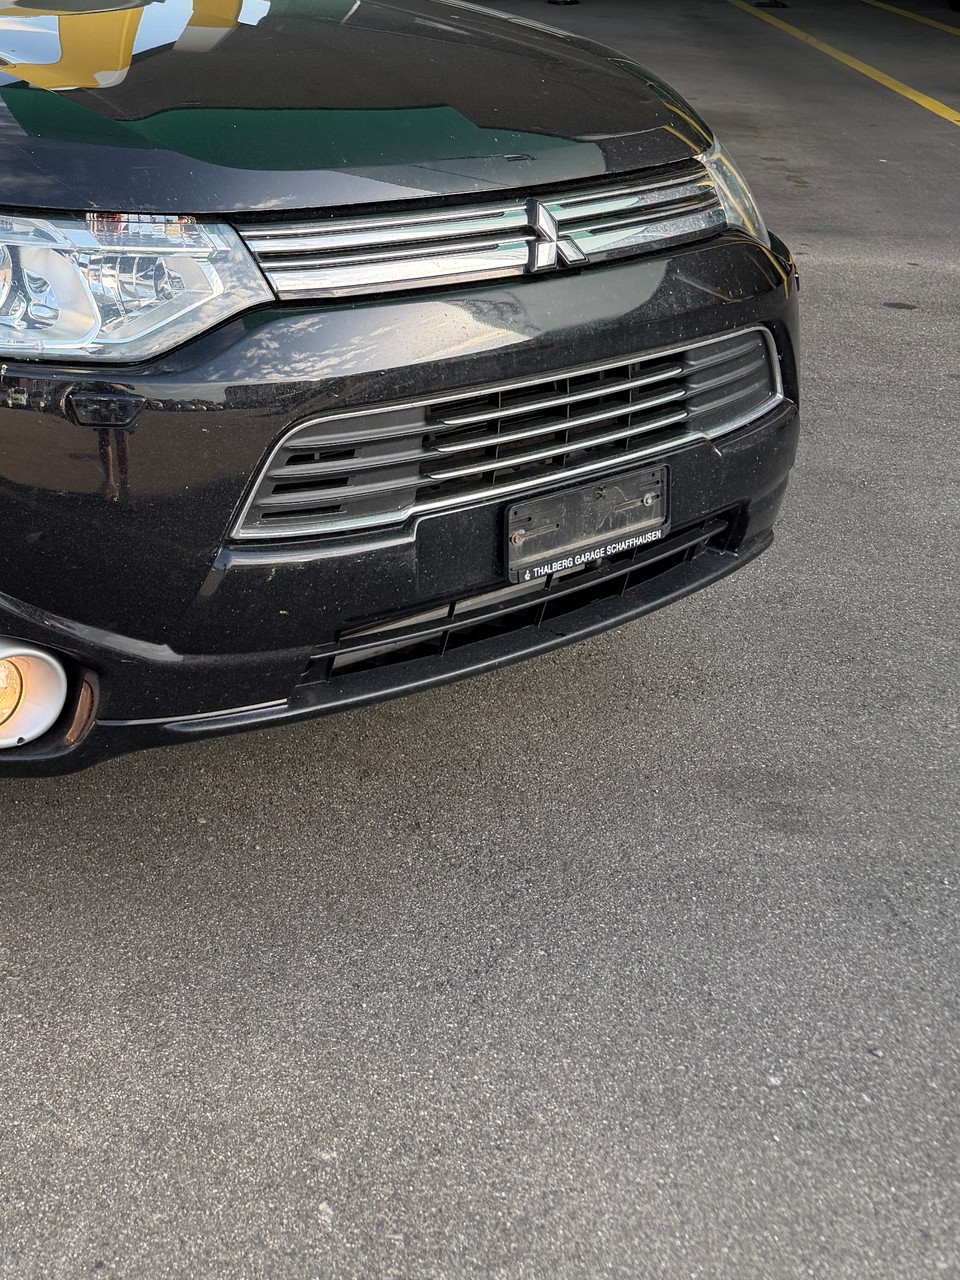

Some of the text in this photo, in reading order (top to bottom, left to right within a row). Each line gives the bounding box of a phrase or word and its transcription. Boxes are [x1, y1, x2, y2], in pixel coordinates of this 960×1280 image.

[533, 530, 662, 578] THALBERG GARAGE SCHAFFHAUSEN
